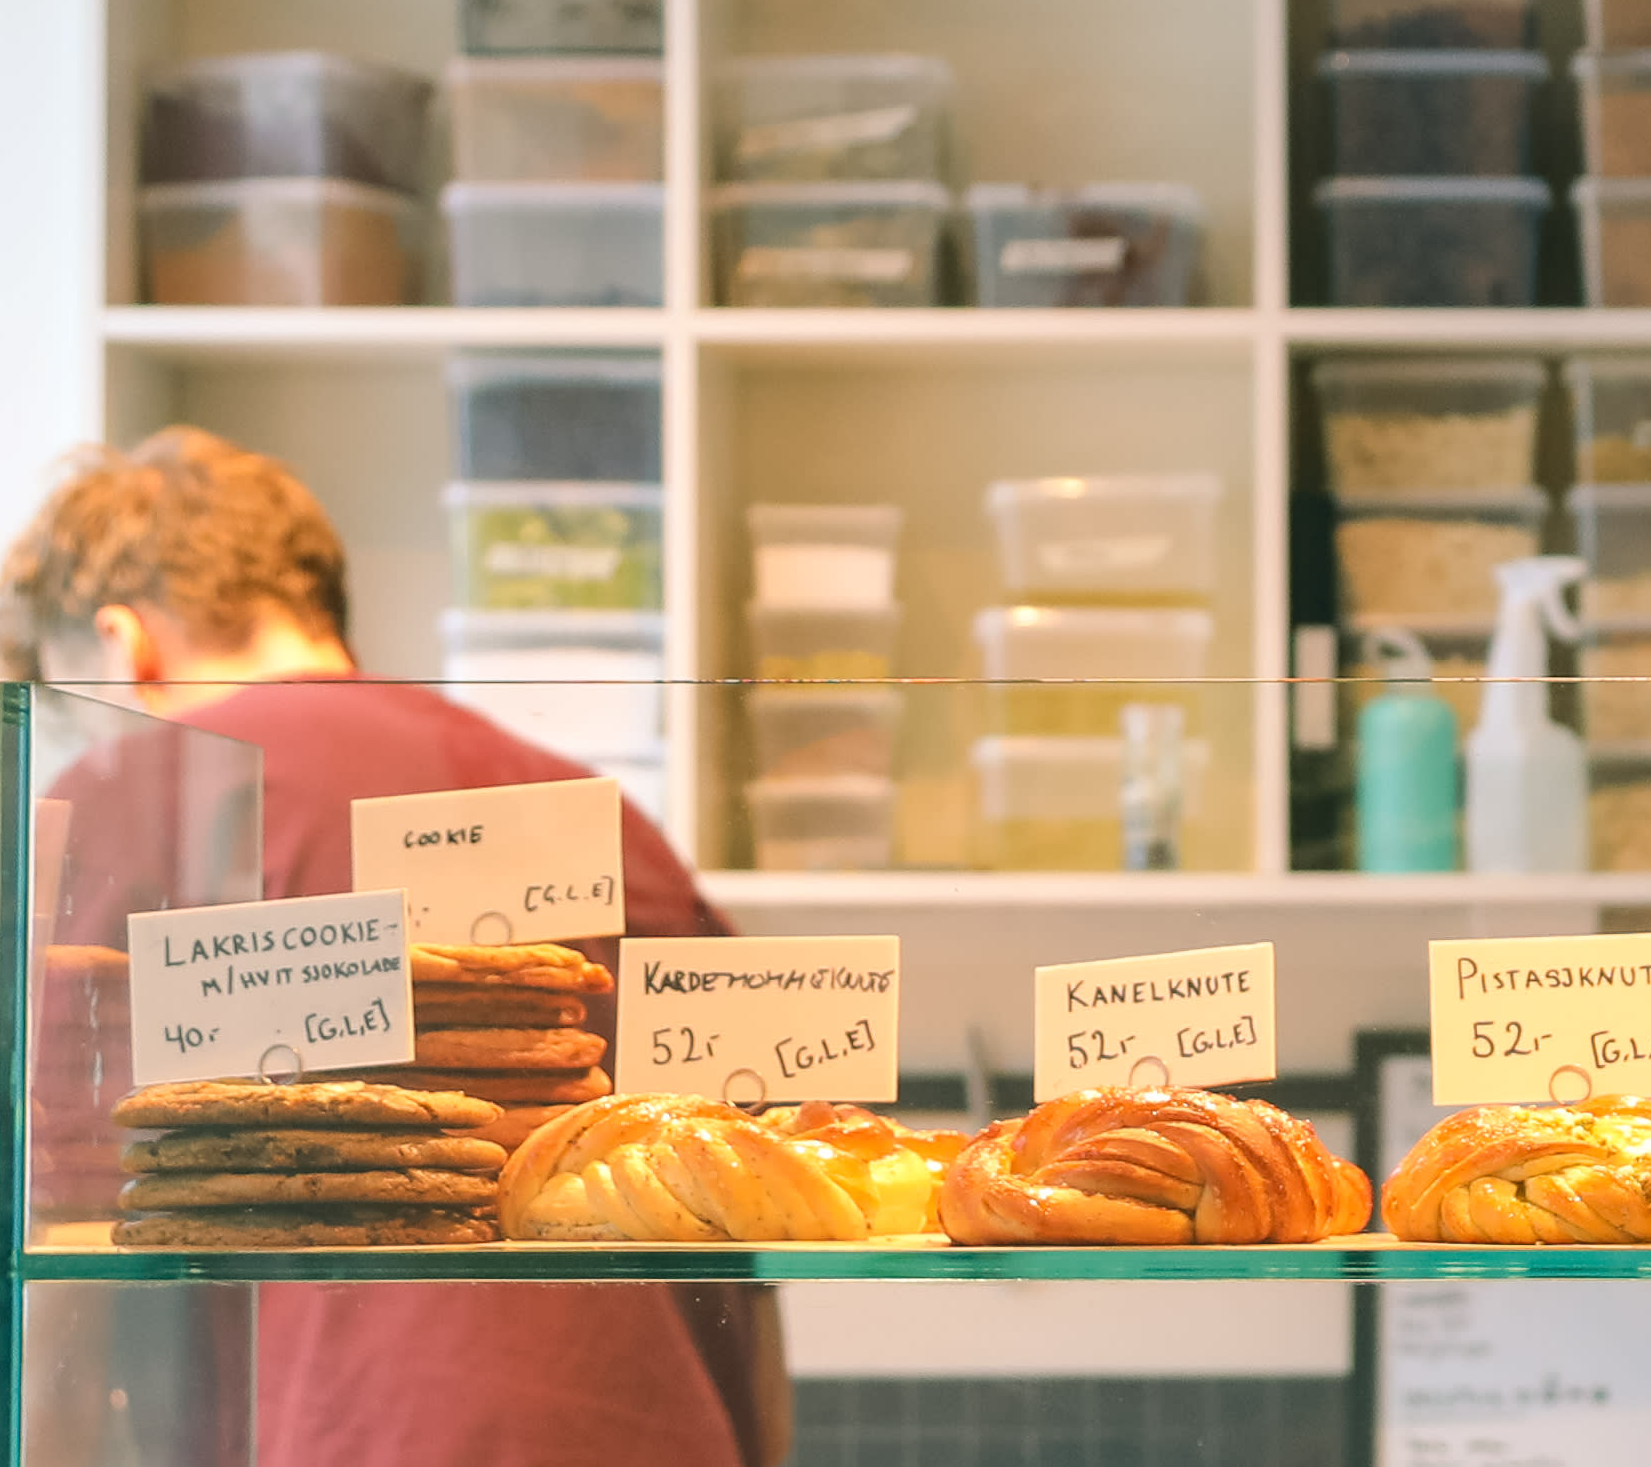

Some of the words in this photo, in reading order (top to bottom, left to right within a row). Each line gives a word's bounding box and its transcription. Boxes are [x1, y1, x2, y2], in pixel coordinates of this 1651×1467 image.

[403, 825, 485, 850] COOKIE
[164, 923, 276, 969] LAKRIS
[1066, 970, 1251, 1013] KANELKNUTE
